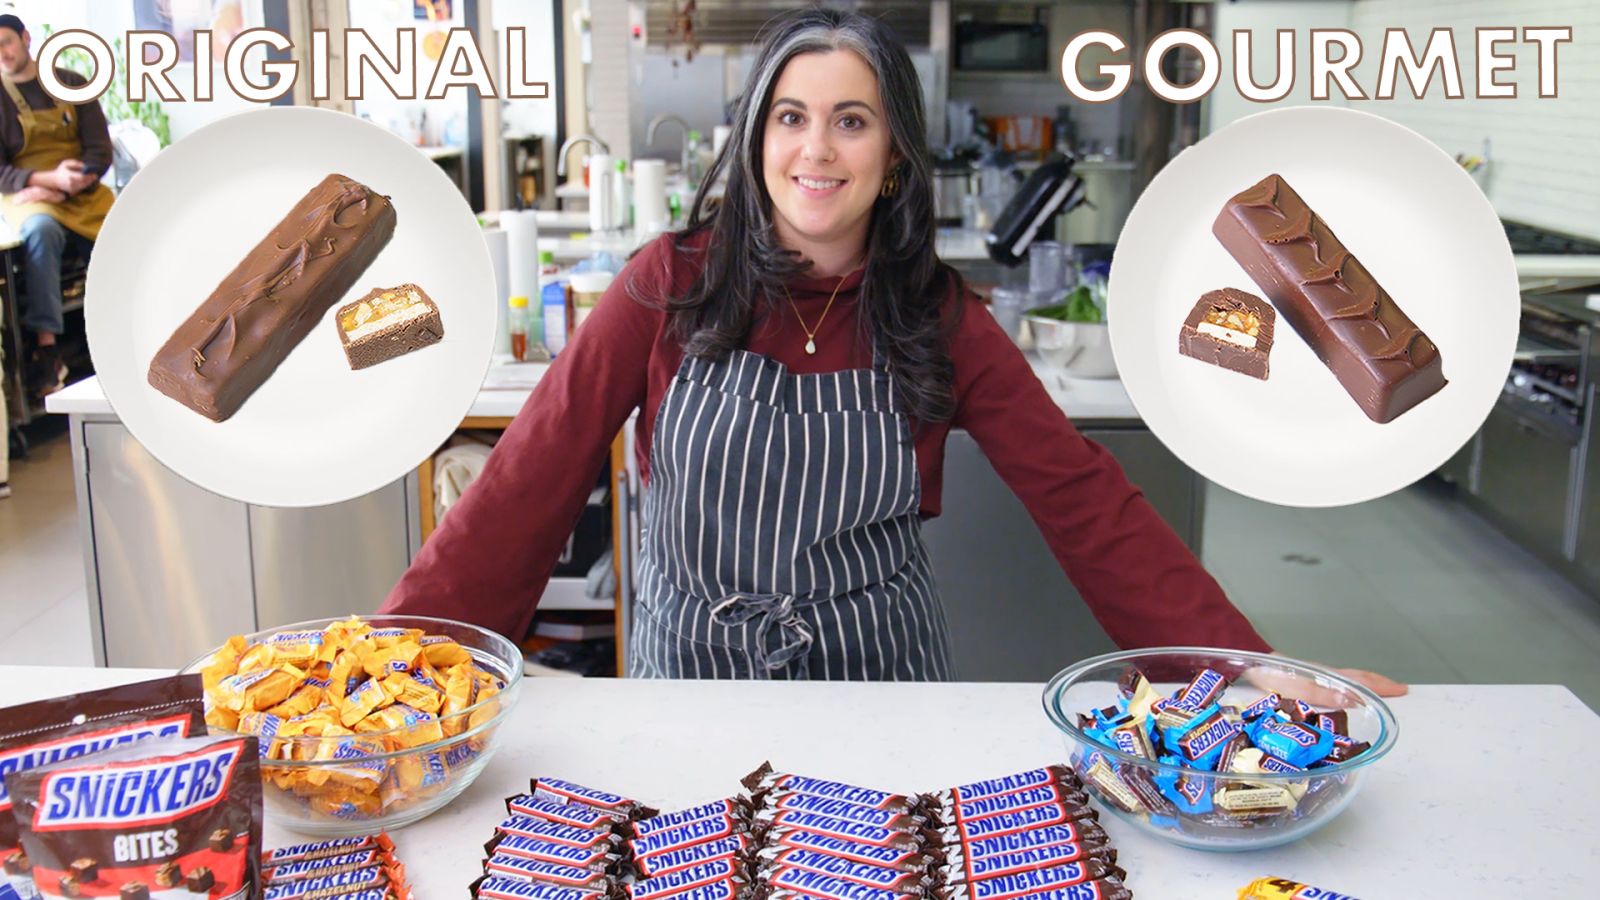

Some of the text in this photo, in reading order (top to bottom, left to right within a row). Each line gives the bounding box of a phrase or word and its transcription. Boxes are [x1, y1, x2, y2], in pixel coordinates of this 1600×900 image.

[47, 752, 235, 821] SNICKERS
[786, 775, 890, 806] SNICKERS
[959, 768, 1049, 800] SNICKERS
[639, 800, 727, 834] SNICKERS
[786, 794, 891, 825] SNICKERS
[962, 786, 1054, 818] SNICKERS
[634, 816, 727, 855] SNICKERS
[783, 811, 891, 841] SNICKERS
[967, 803, 1061, 837] SNICKERS
[113, 828, 180, 863] BITES
[645, 836, 741, 873] SNICKERS
[970, 824, 1072, 858] SNICKERS
[973, 844, 1076, 874] SNICKERS
[265, 866, 379, 900] SNICKERS
[633, 860, 729, 897] SNICKERS
[977, 862, 1082, 897] SNICKERS
